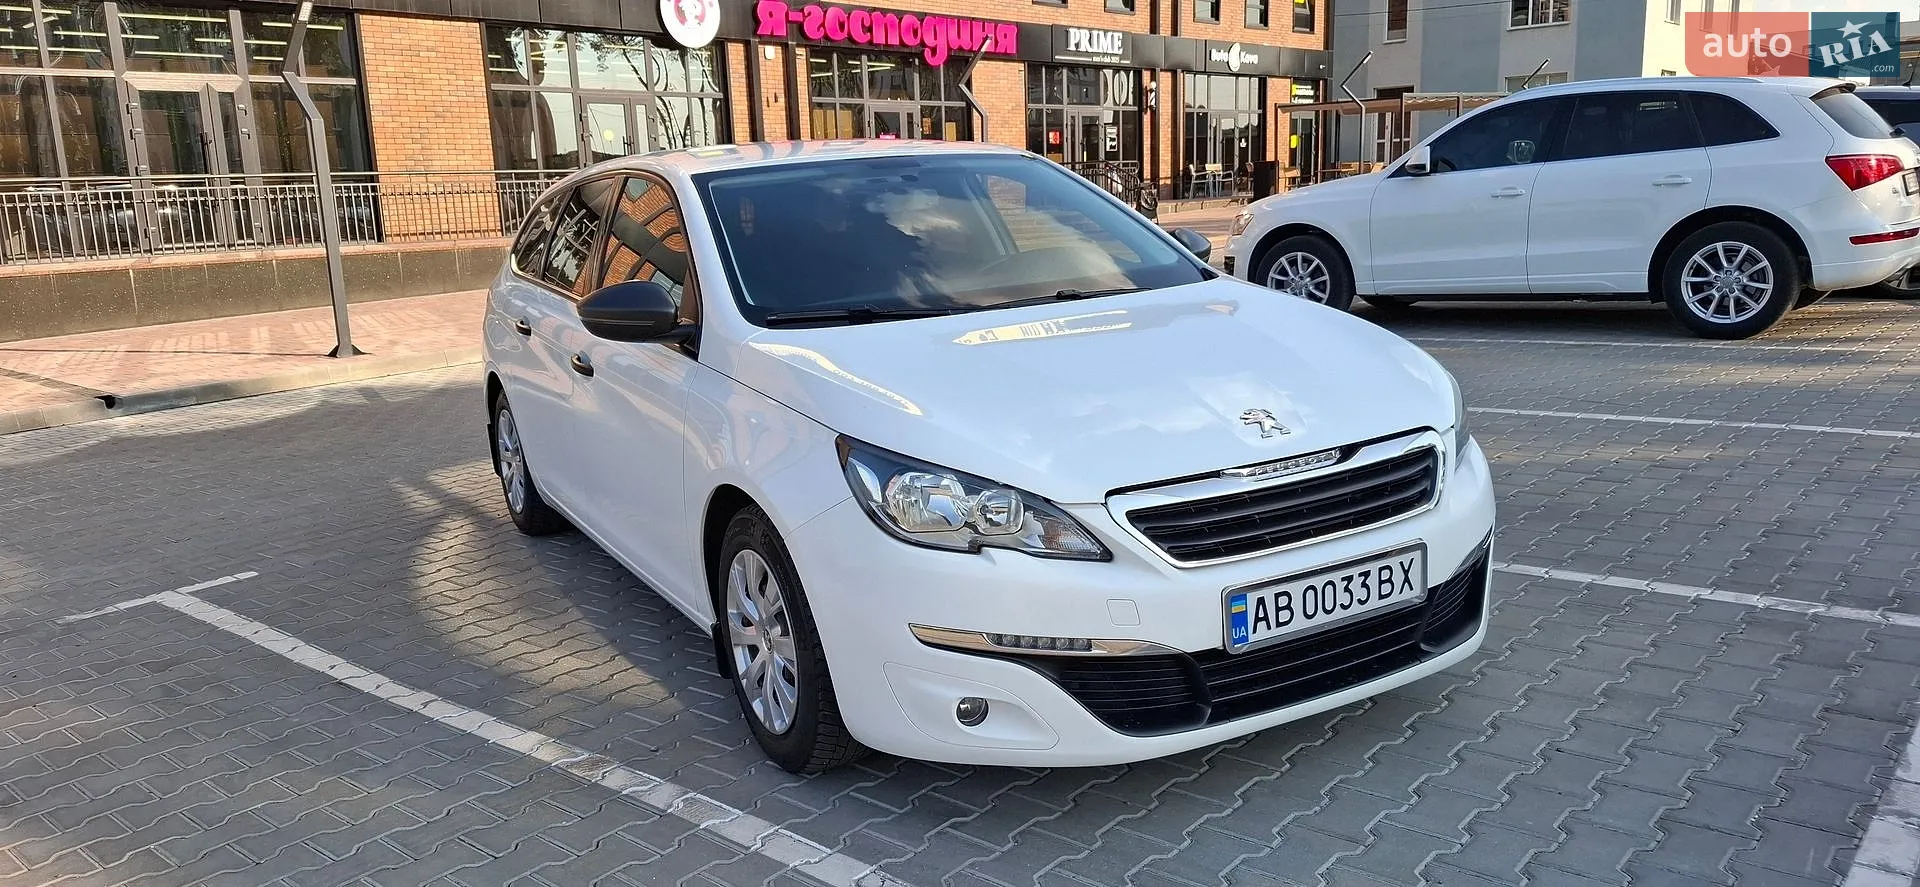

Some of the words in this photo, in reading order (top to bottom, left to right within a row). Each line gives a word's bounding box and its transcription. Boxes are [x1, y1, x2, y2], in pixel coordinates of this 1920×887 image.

[1067, 28, 1123, 54] PRIME
[1252, 591, 1295, 634] AB
[1303, 570, 1371, 619] 0033
[1378, 558, 1414, 600] BX
[1232, 626, 1247, 639] UA
